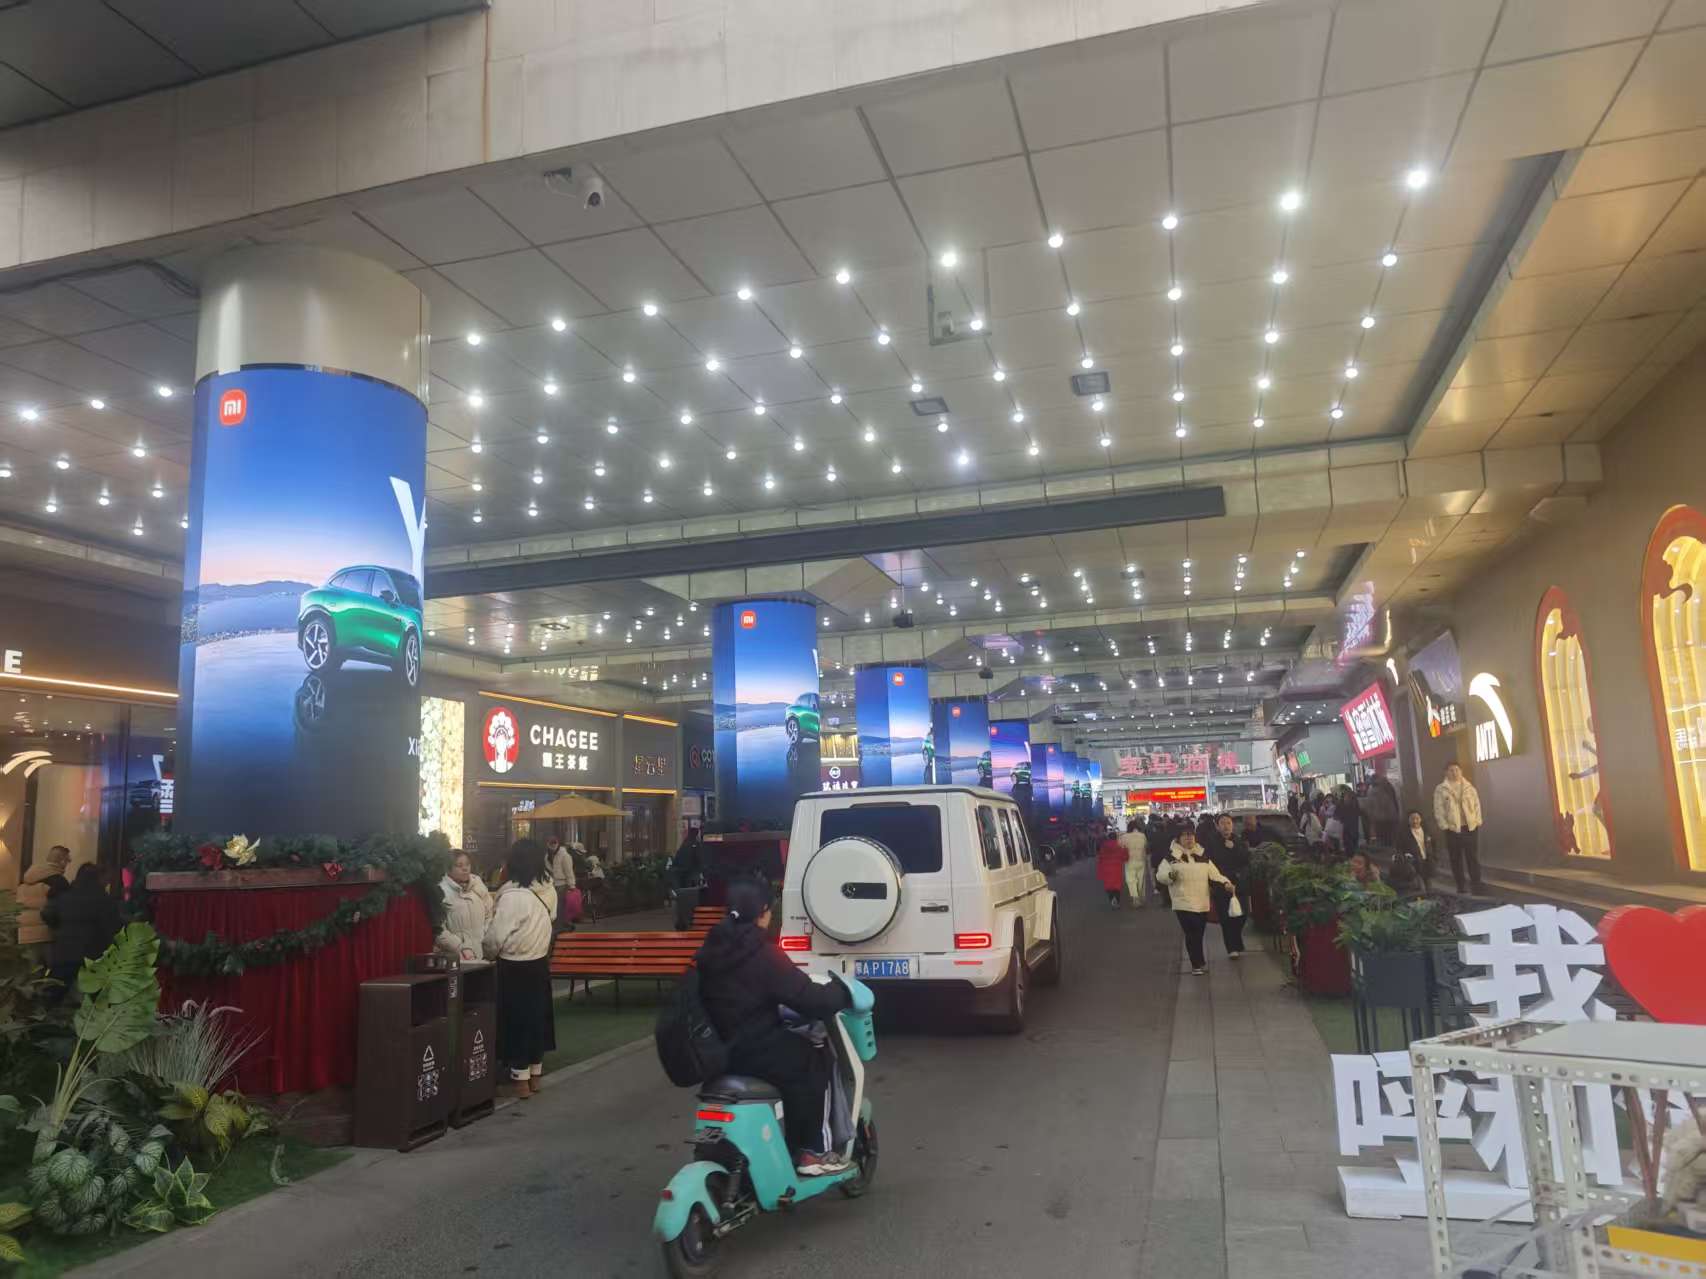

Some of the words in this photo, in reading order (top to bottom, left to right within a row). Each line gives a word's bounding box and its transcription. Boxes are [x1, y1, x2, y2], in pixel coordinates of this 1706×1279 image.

[407, 736, 419, 756] Xi
[529, 724, 600, 751] CHAGEE
[1475, 720, 1499, 763] ANTA
[1454, 903, 1617, 1024] 我
